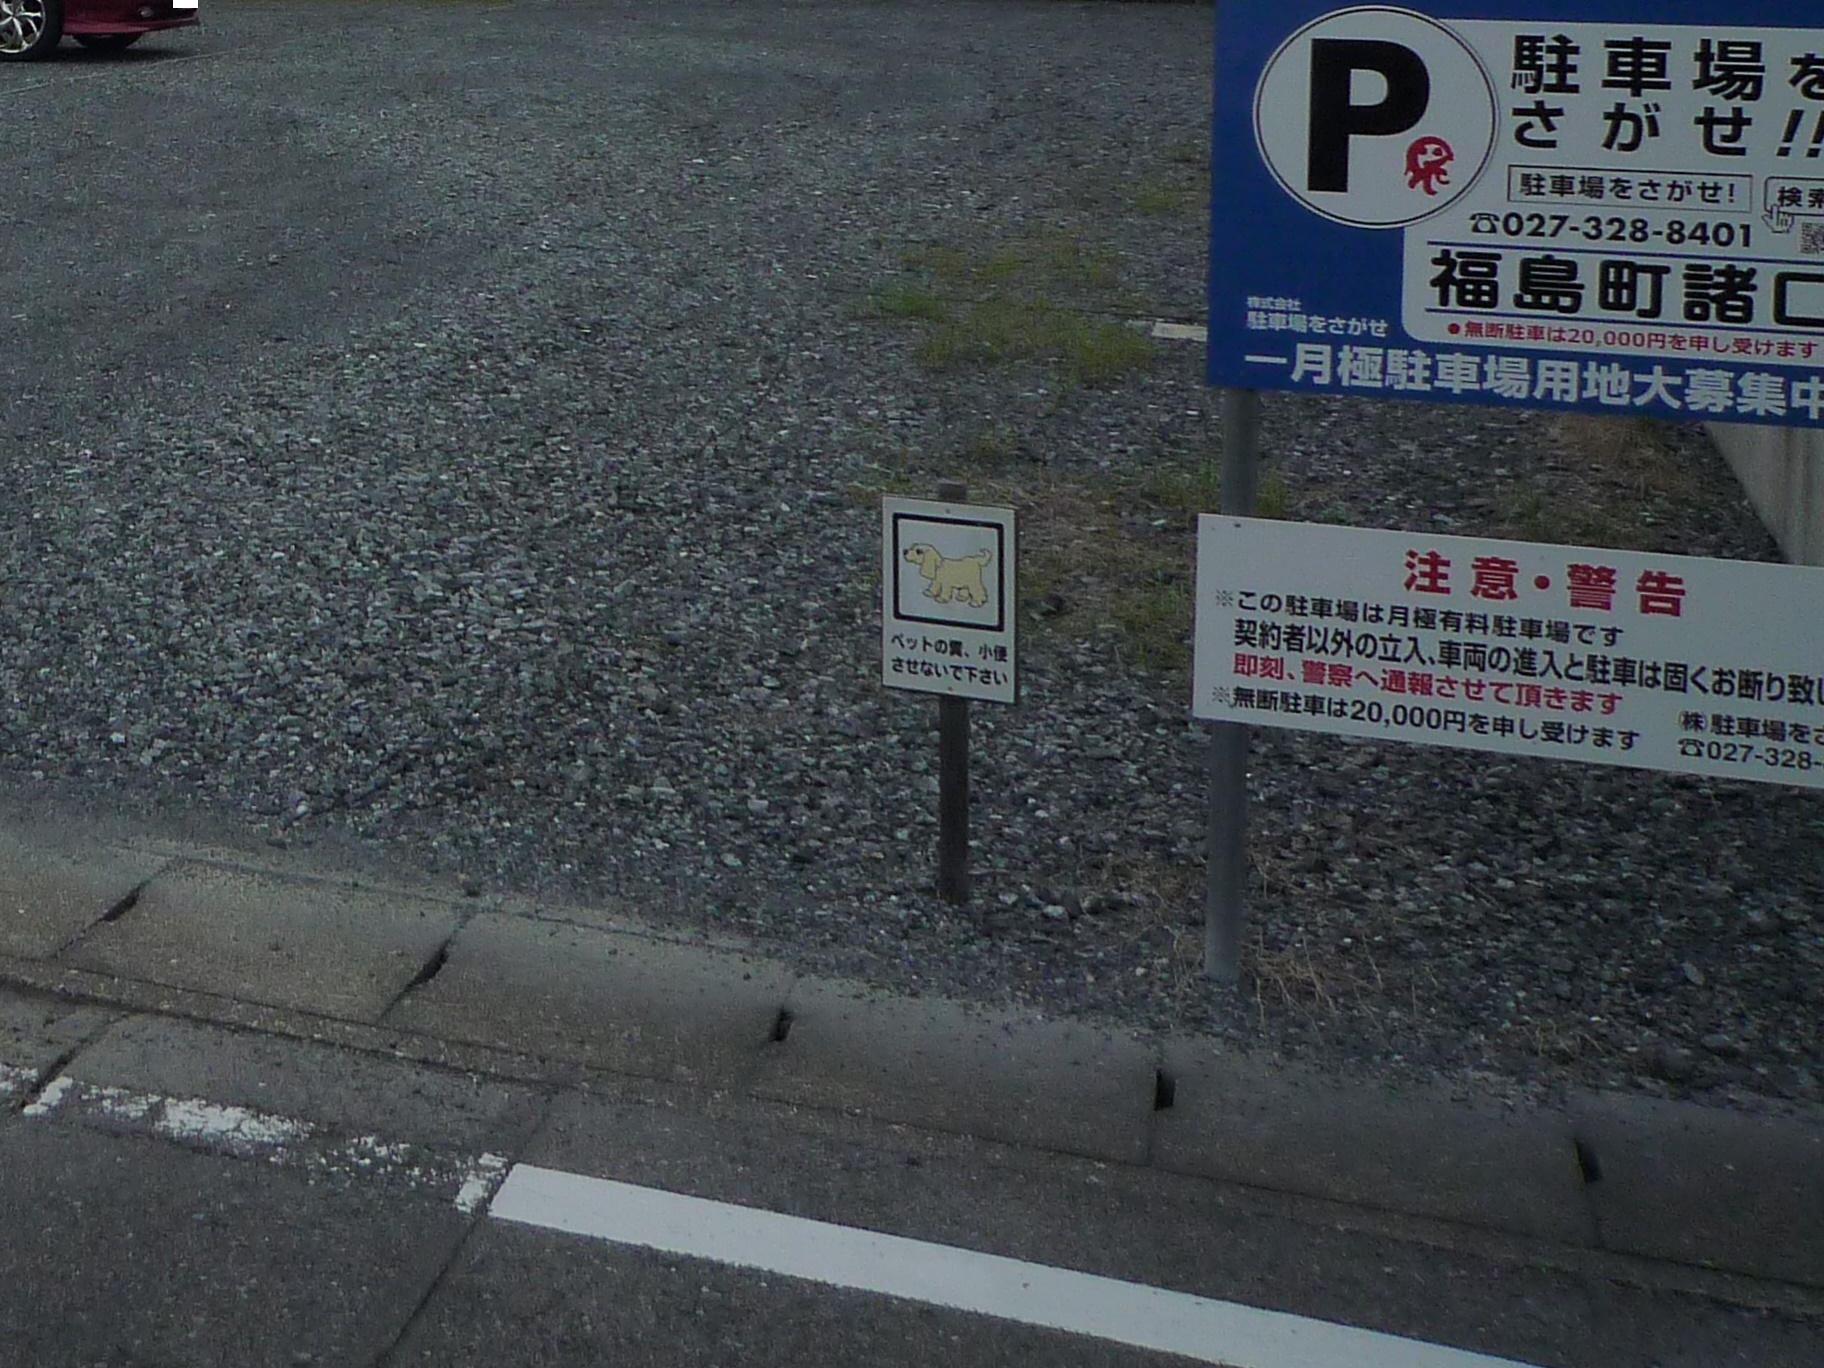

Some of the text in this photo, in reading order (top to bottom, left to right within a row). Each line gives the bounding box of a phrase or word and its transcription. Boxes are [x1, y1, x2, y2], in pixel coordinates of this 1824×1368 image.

[1510, 33, 1824, 102] 駐車場を
[1306, 37, 1431, 194] P
[1502, 211, 1752, 248] 027-328-8401
[1245, 311, 1388, 338] 駐車場をさがせ
[1706, 744, 1824, 770] 027-328-
